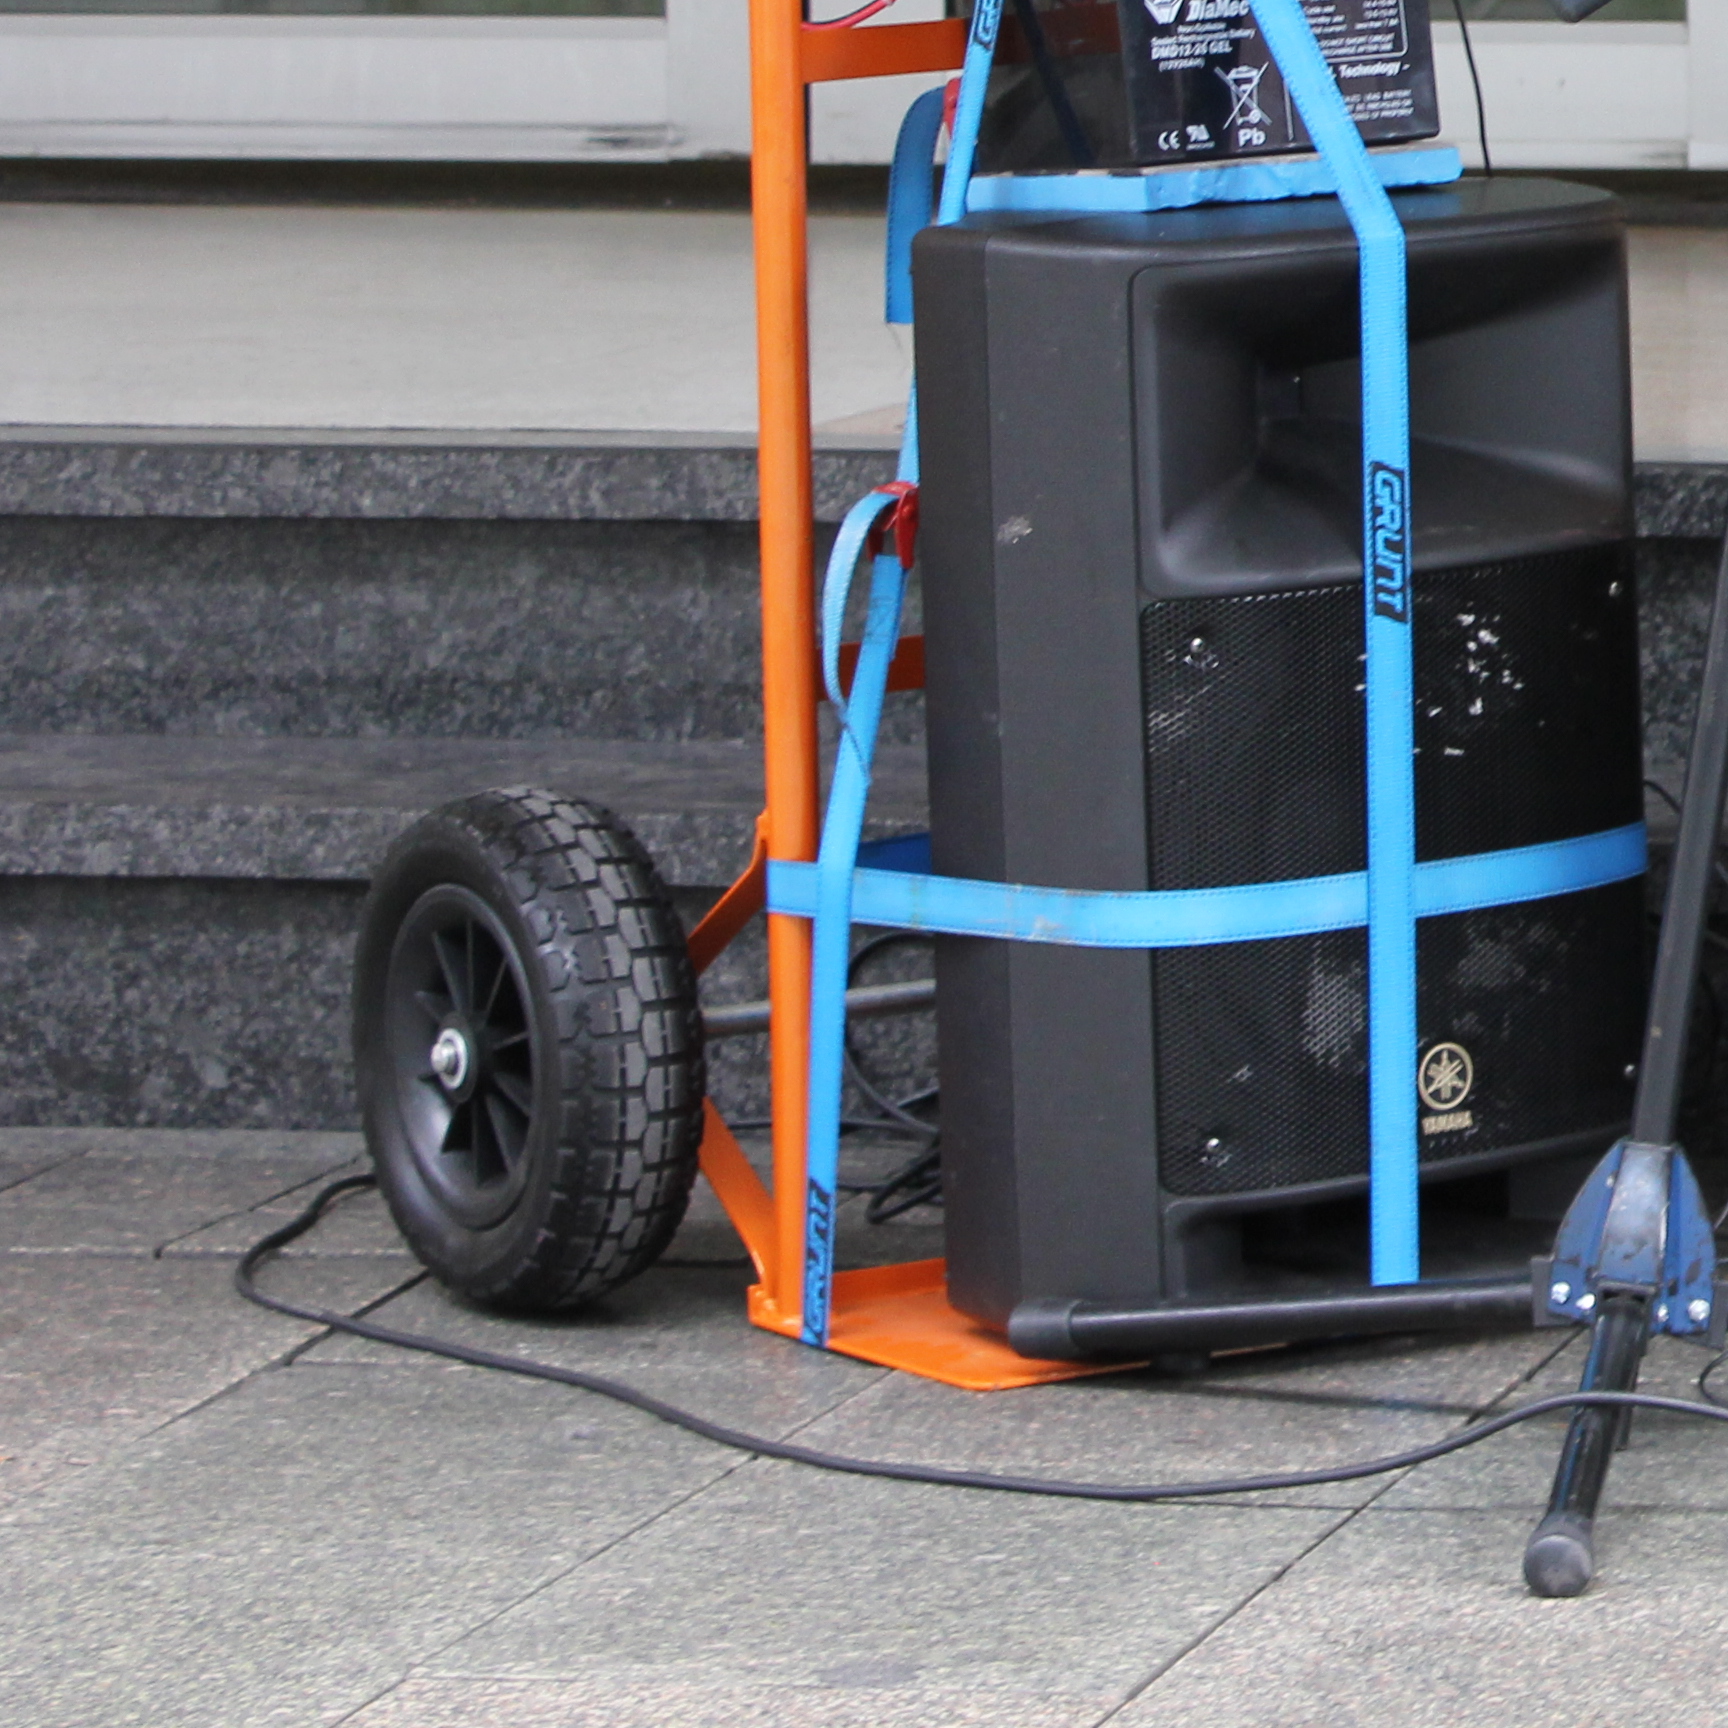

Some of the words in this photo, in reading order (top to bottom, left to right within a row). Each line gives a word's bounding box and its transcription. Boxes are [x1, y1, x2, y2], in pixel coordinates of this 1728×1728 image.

[1209, 39, 1233, 53] GEL
[1339, 61, 1401, 78] Technology
[1238, 127, 1266, 147] Pb
[1373, 469, 1404, 614] GRUNT
[1422, 1110, 1473, 1135] YAMAHA
